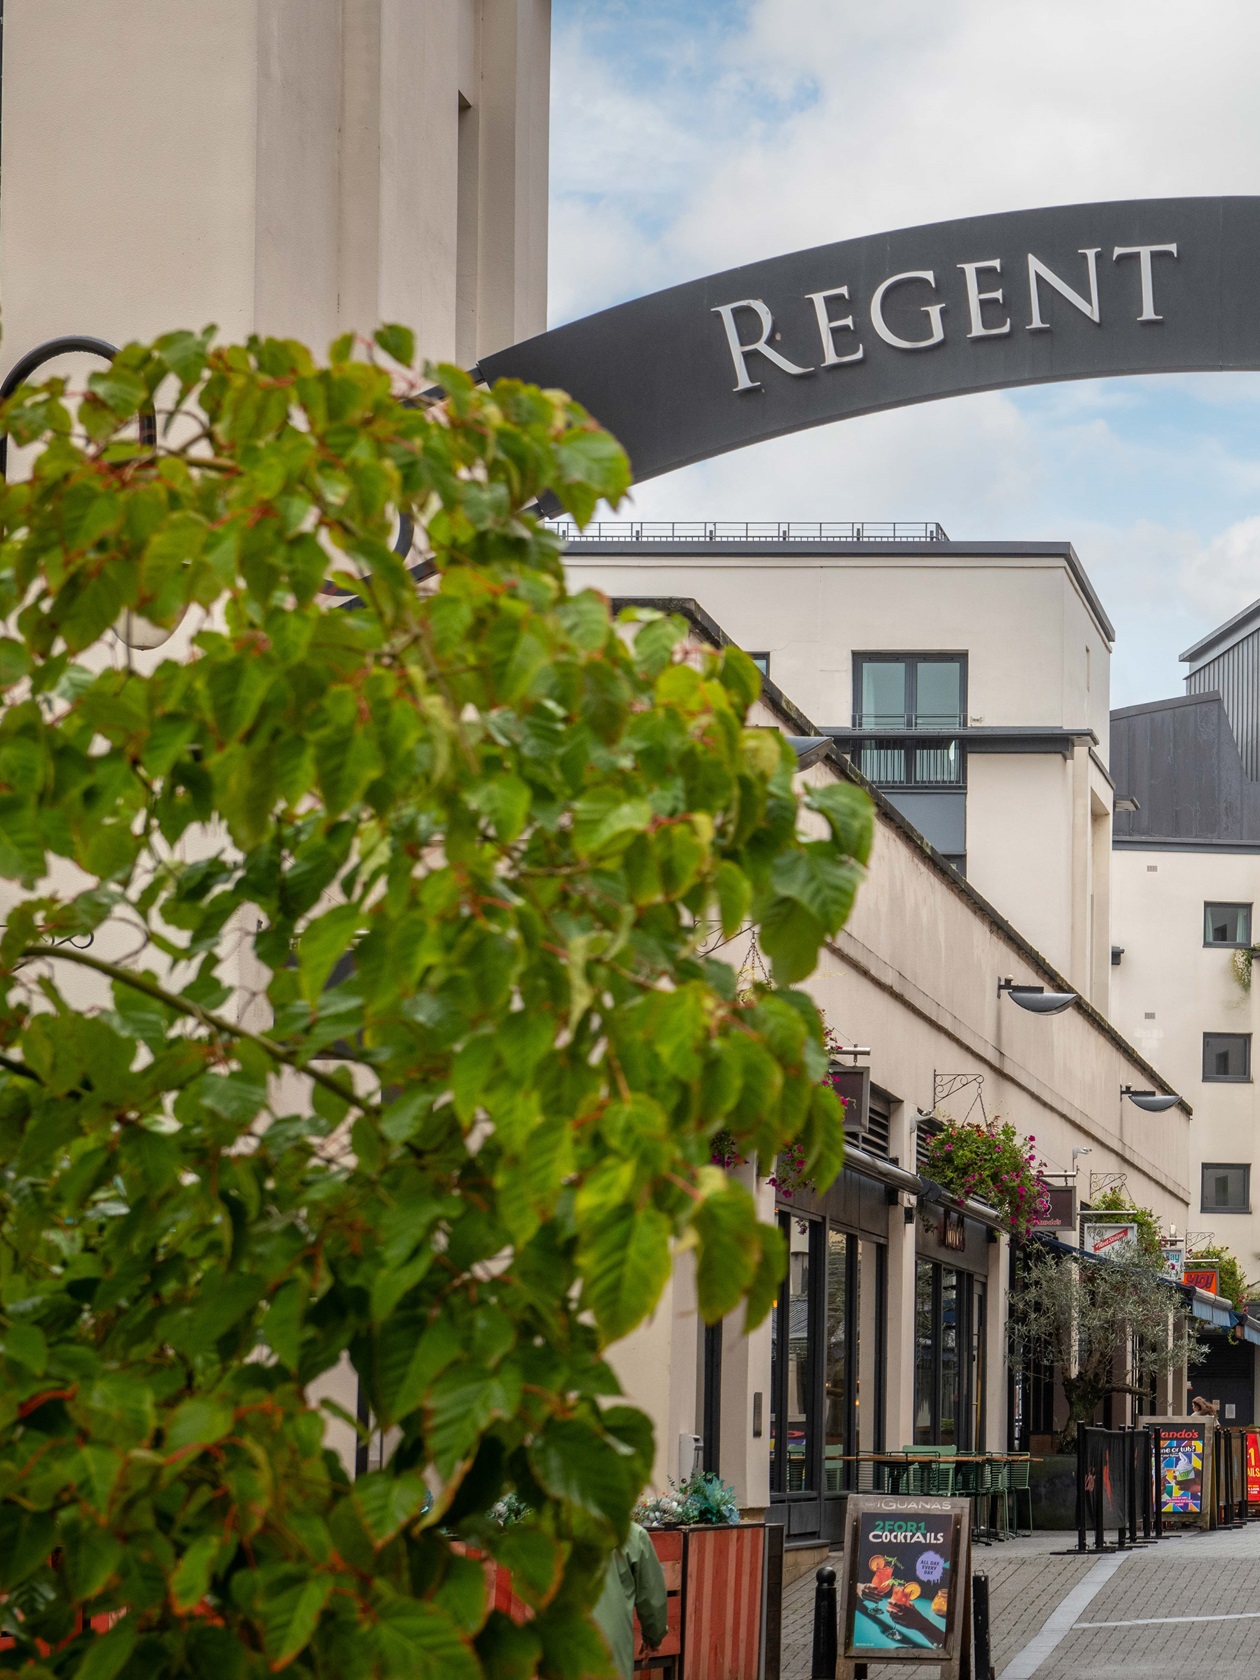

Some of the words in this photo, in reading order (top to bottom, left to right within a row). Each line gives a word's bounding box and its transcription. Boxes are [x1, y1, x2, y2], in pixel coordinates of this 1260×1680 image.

[711, 242, 1179, 392] REGENT
[1166, 1252, 1180, 1263] Bay
[1187, 1274, 1214, 1289] YO!
[877, 1498, 951, 1510] IGUANAS
[869, 1532, 944, 1544] COCKTAILS
